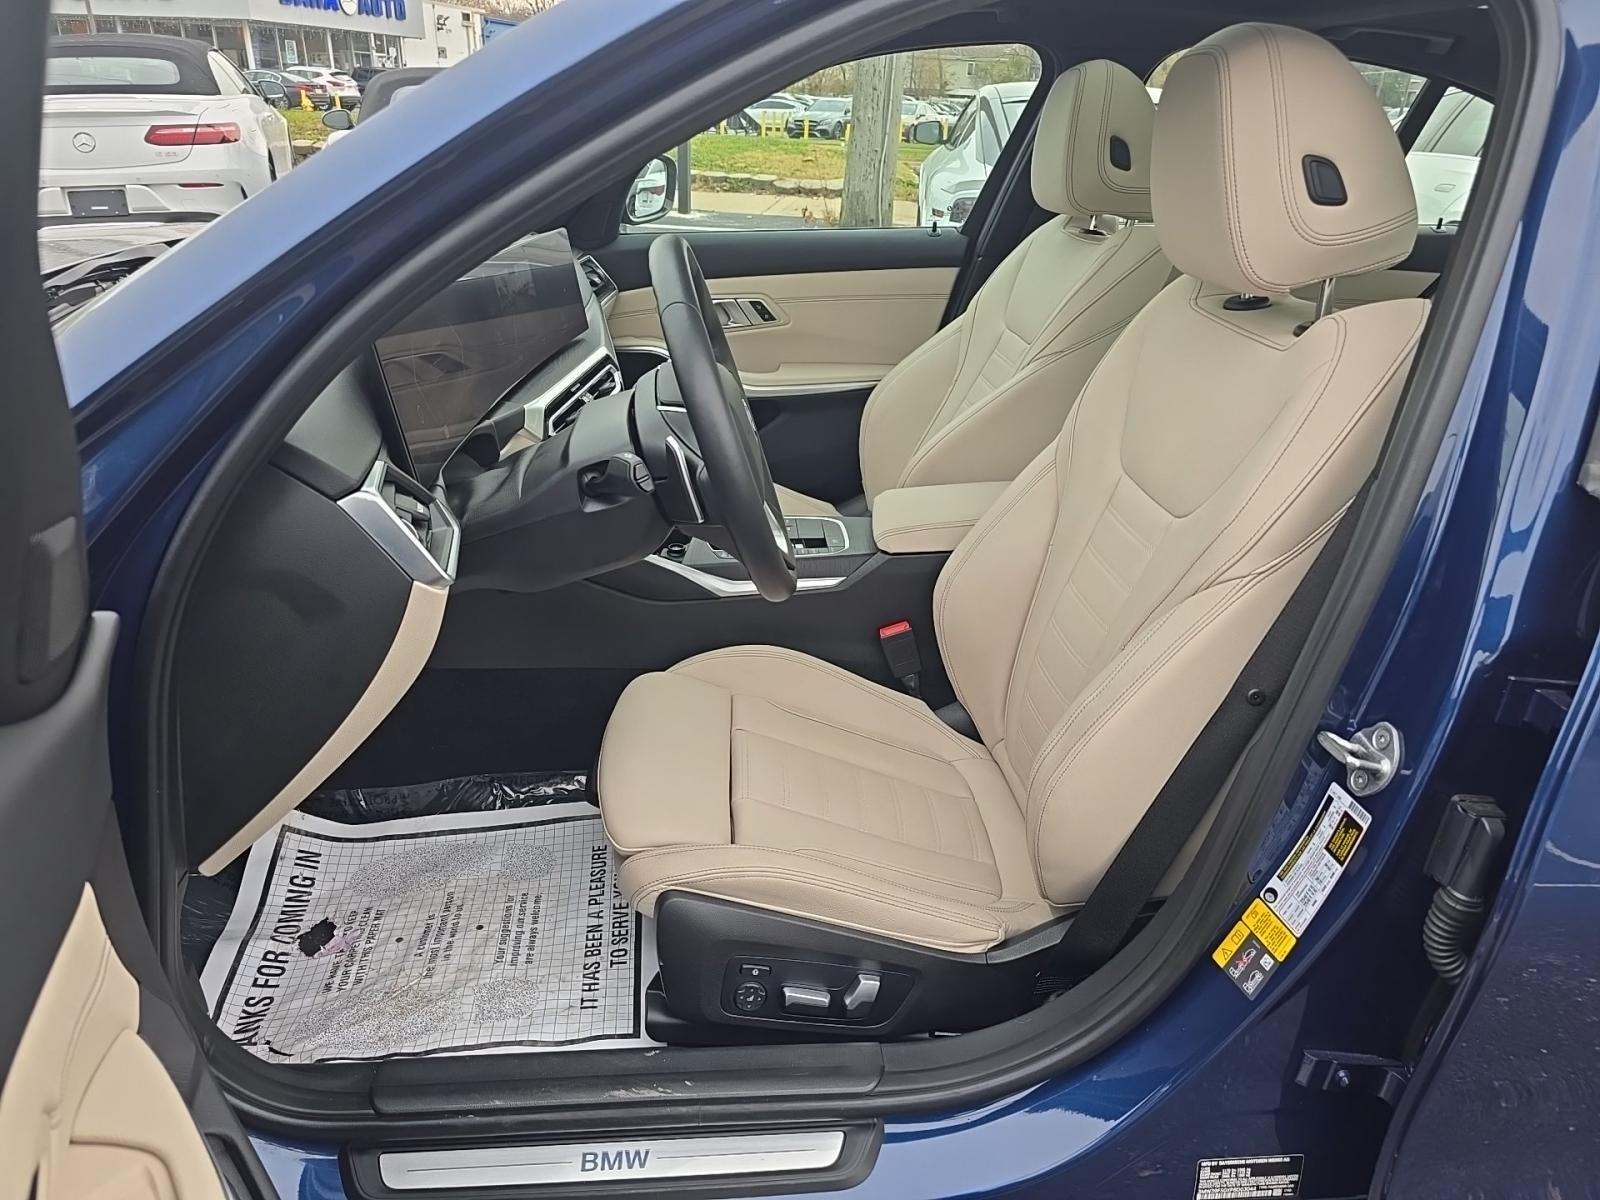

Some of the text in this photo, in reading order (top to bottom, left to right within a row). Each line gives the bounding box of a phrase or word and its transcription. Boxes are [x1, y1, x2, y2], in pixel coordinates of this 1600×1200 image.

[519, 893, 528, 916] service
[498, 906, 512, 945] suggestions
[580, 845, 607, 1009] IT HAS BEEN A PLEASURE
[611, 903, 628, 944] SERVE
[365, 924, 380, 945] PAPER
[232, 849, 321, 1046] ANKS FOR COMING IN
[358, 948, 372, 964] THIS
[494, 948, 505, 964] Your
[610, 948, 627, 968] TO
[336, 971, 351, 992] YOUR
[352, 965, 367, 986] WITH
[321, 983, 333, 993] WE
[579, 1149, 650, 1172] BMW
